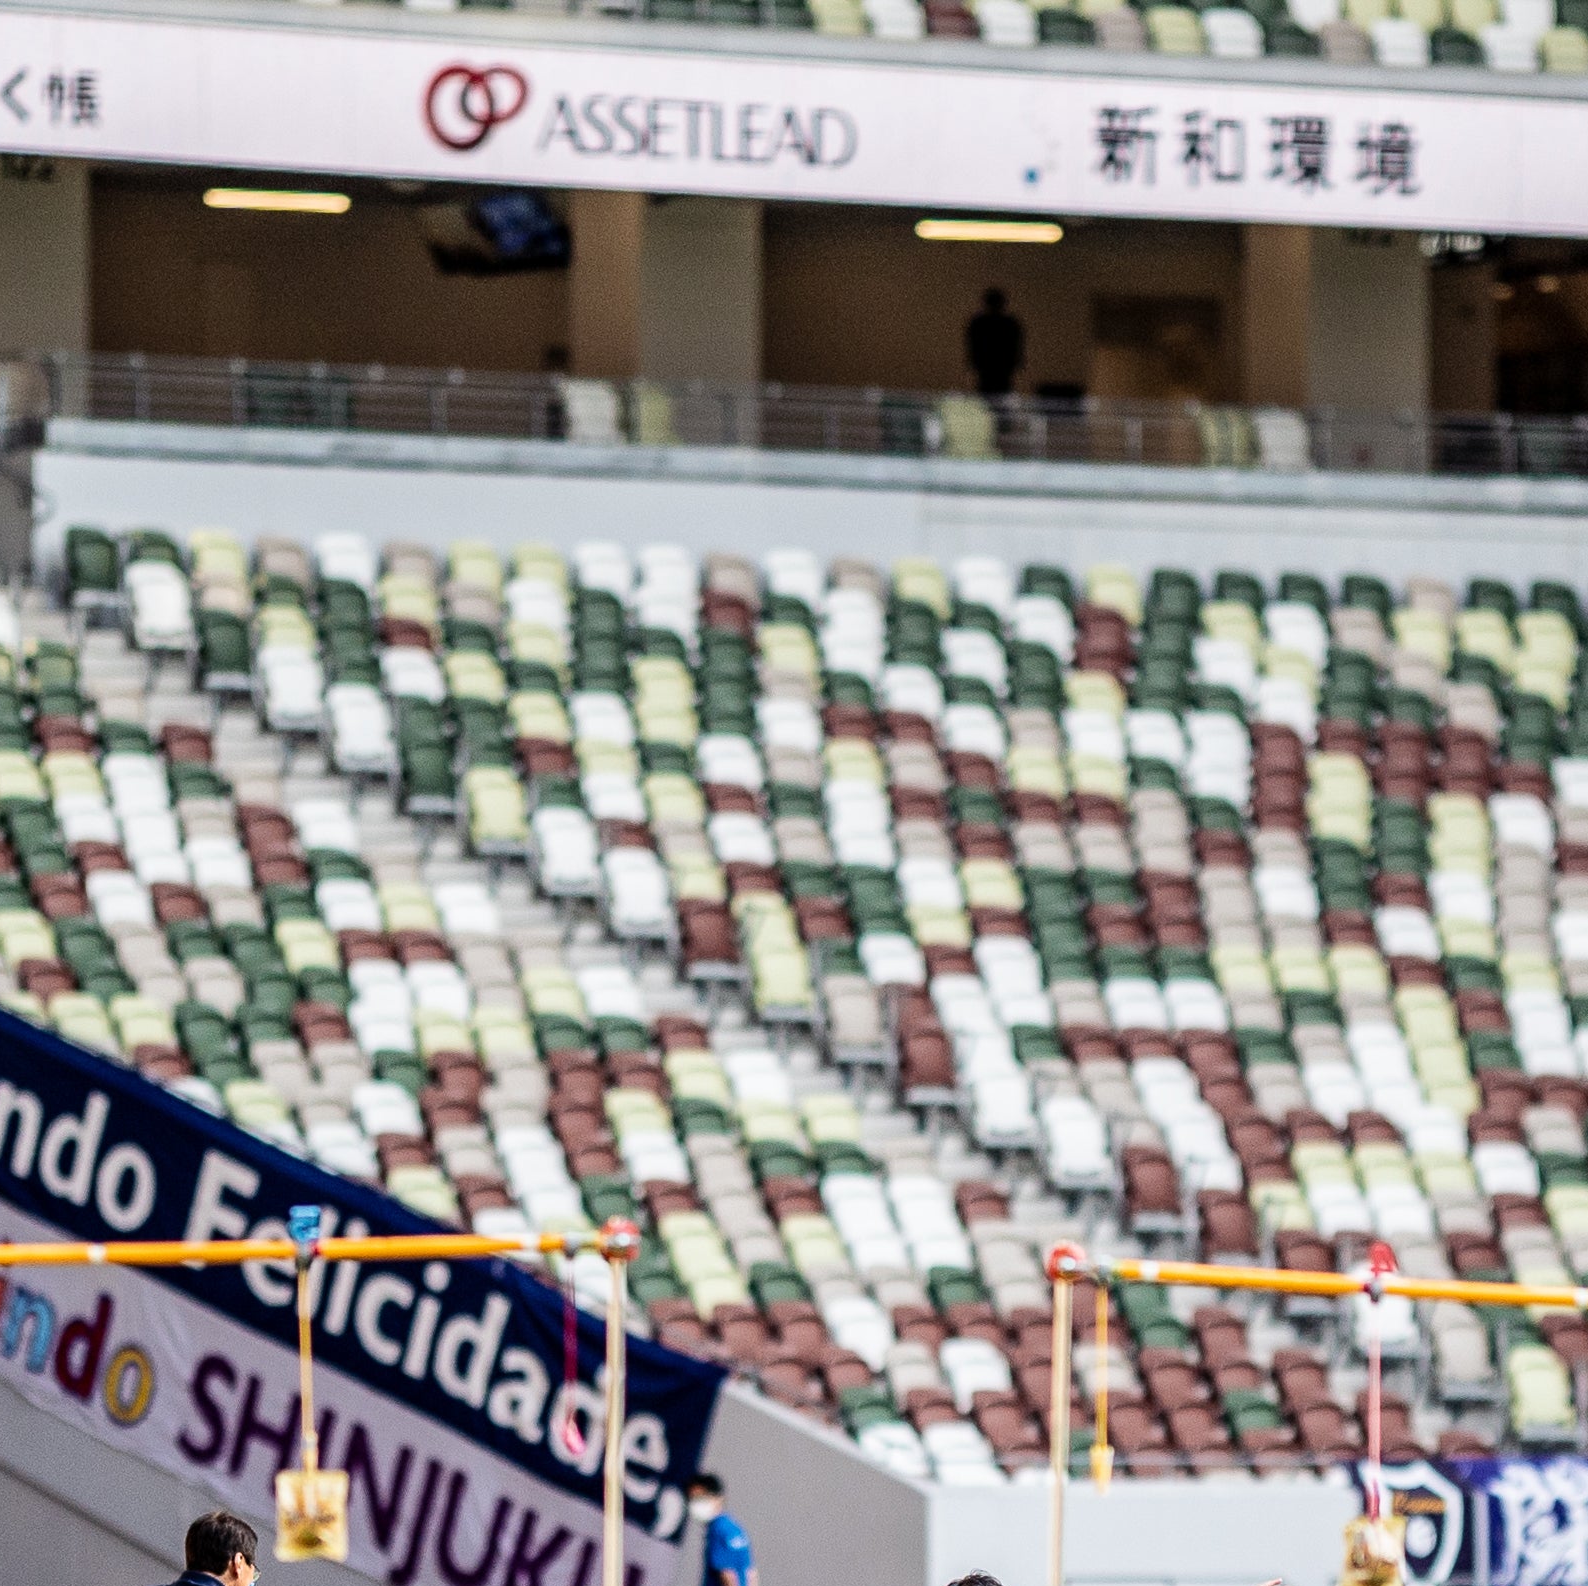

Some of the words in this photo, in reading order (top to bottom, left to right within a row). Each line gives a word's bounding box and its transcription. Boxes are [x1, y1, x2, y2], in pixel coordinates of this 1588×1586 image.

[537, 93, 858, 170] ASSETLEAD
[1092, 105, 1421, 197] 新和環境
